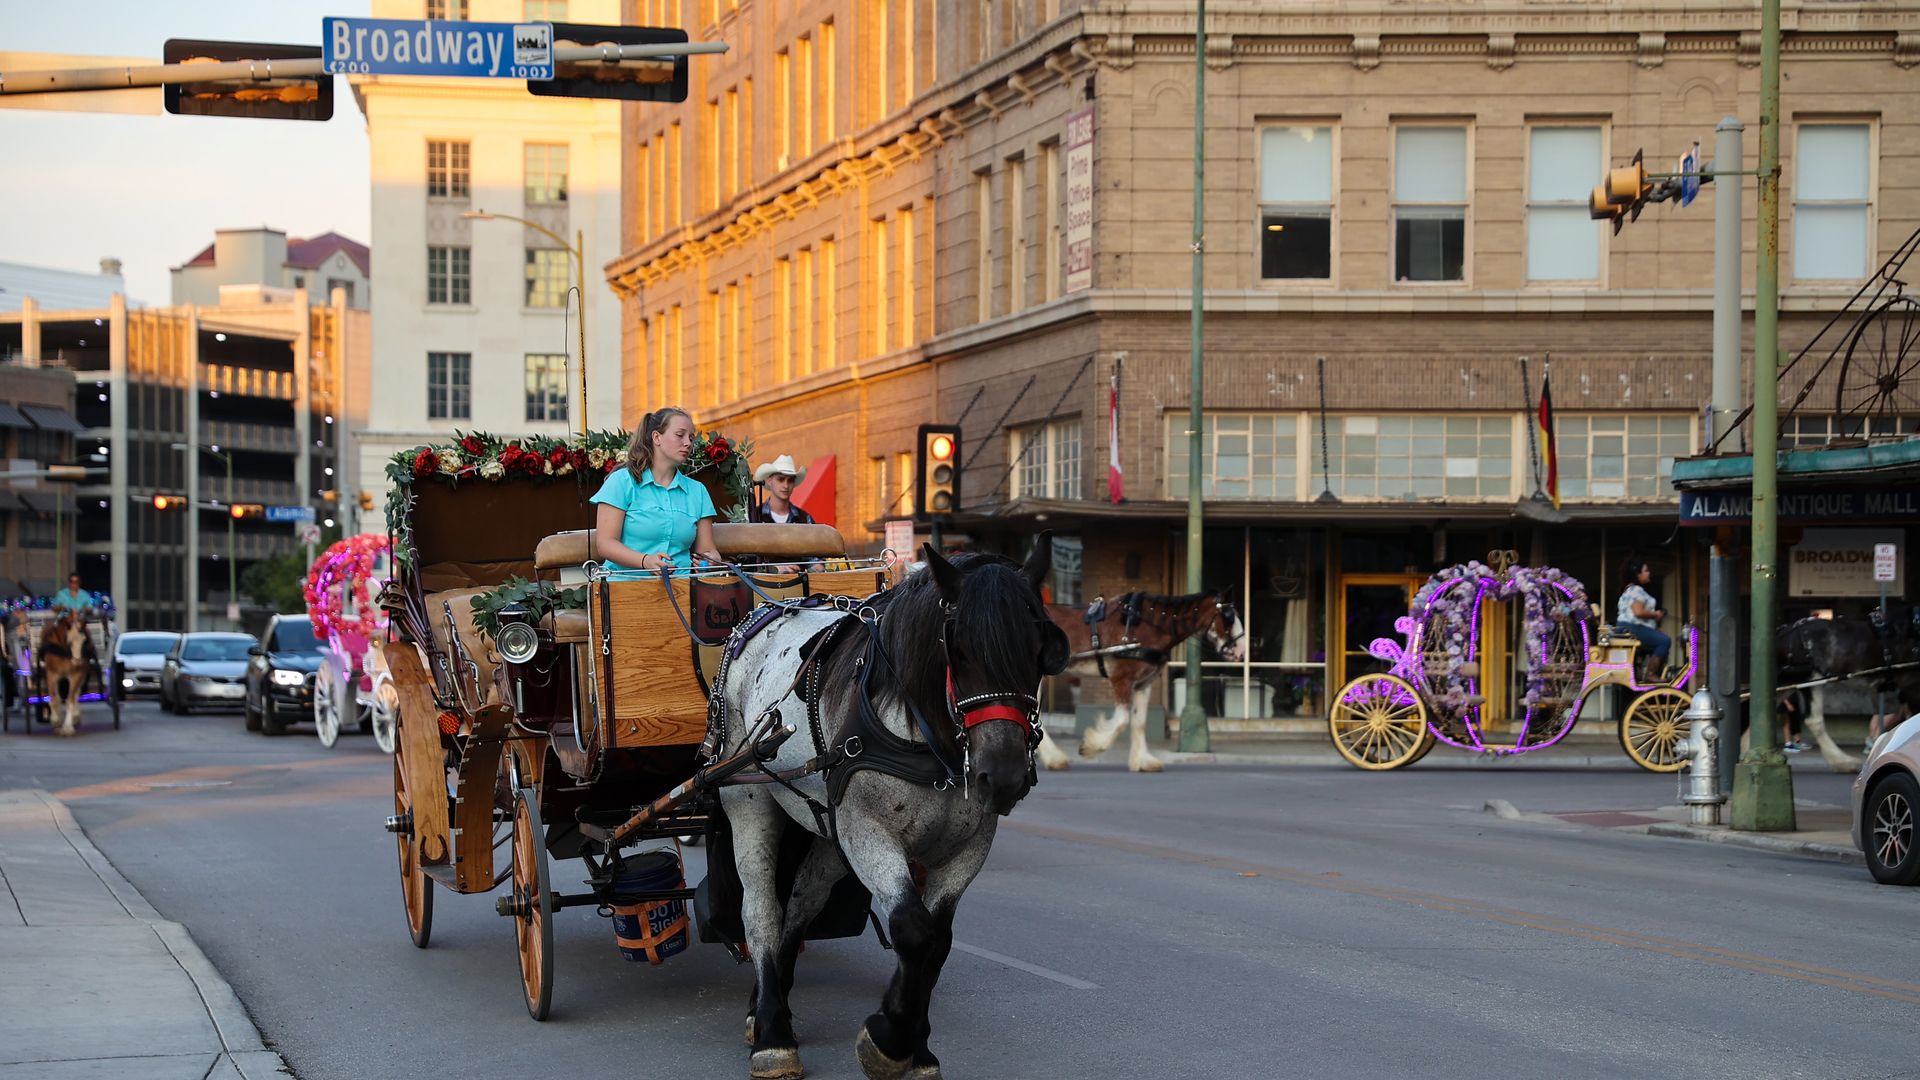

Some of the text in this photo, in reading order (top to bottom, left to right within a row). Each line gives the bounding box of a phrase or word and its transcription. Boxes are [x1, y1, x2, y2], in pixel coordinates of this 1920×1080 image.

[332, 20, 504, 76] Broadway
[338, 61, 539, 78] 200 100
[1069, 184, 1090, 206] Office
[1068, 209, 1090, 234] Space
[1865, 493, 1917, 512] MALL
[1794, 550, 1899, 564] BROADW
[648, 905, 668, 921] DO
